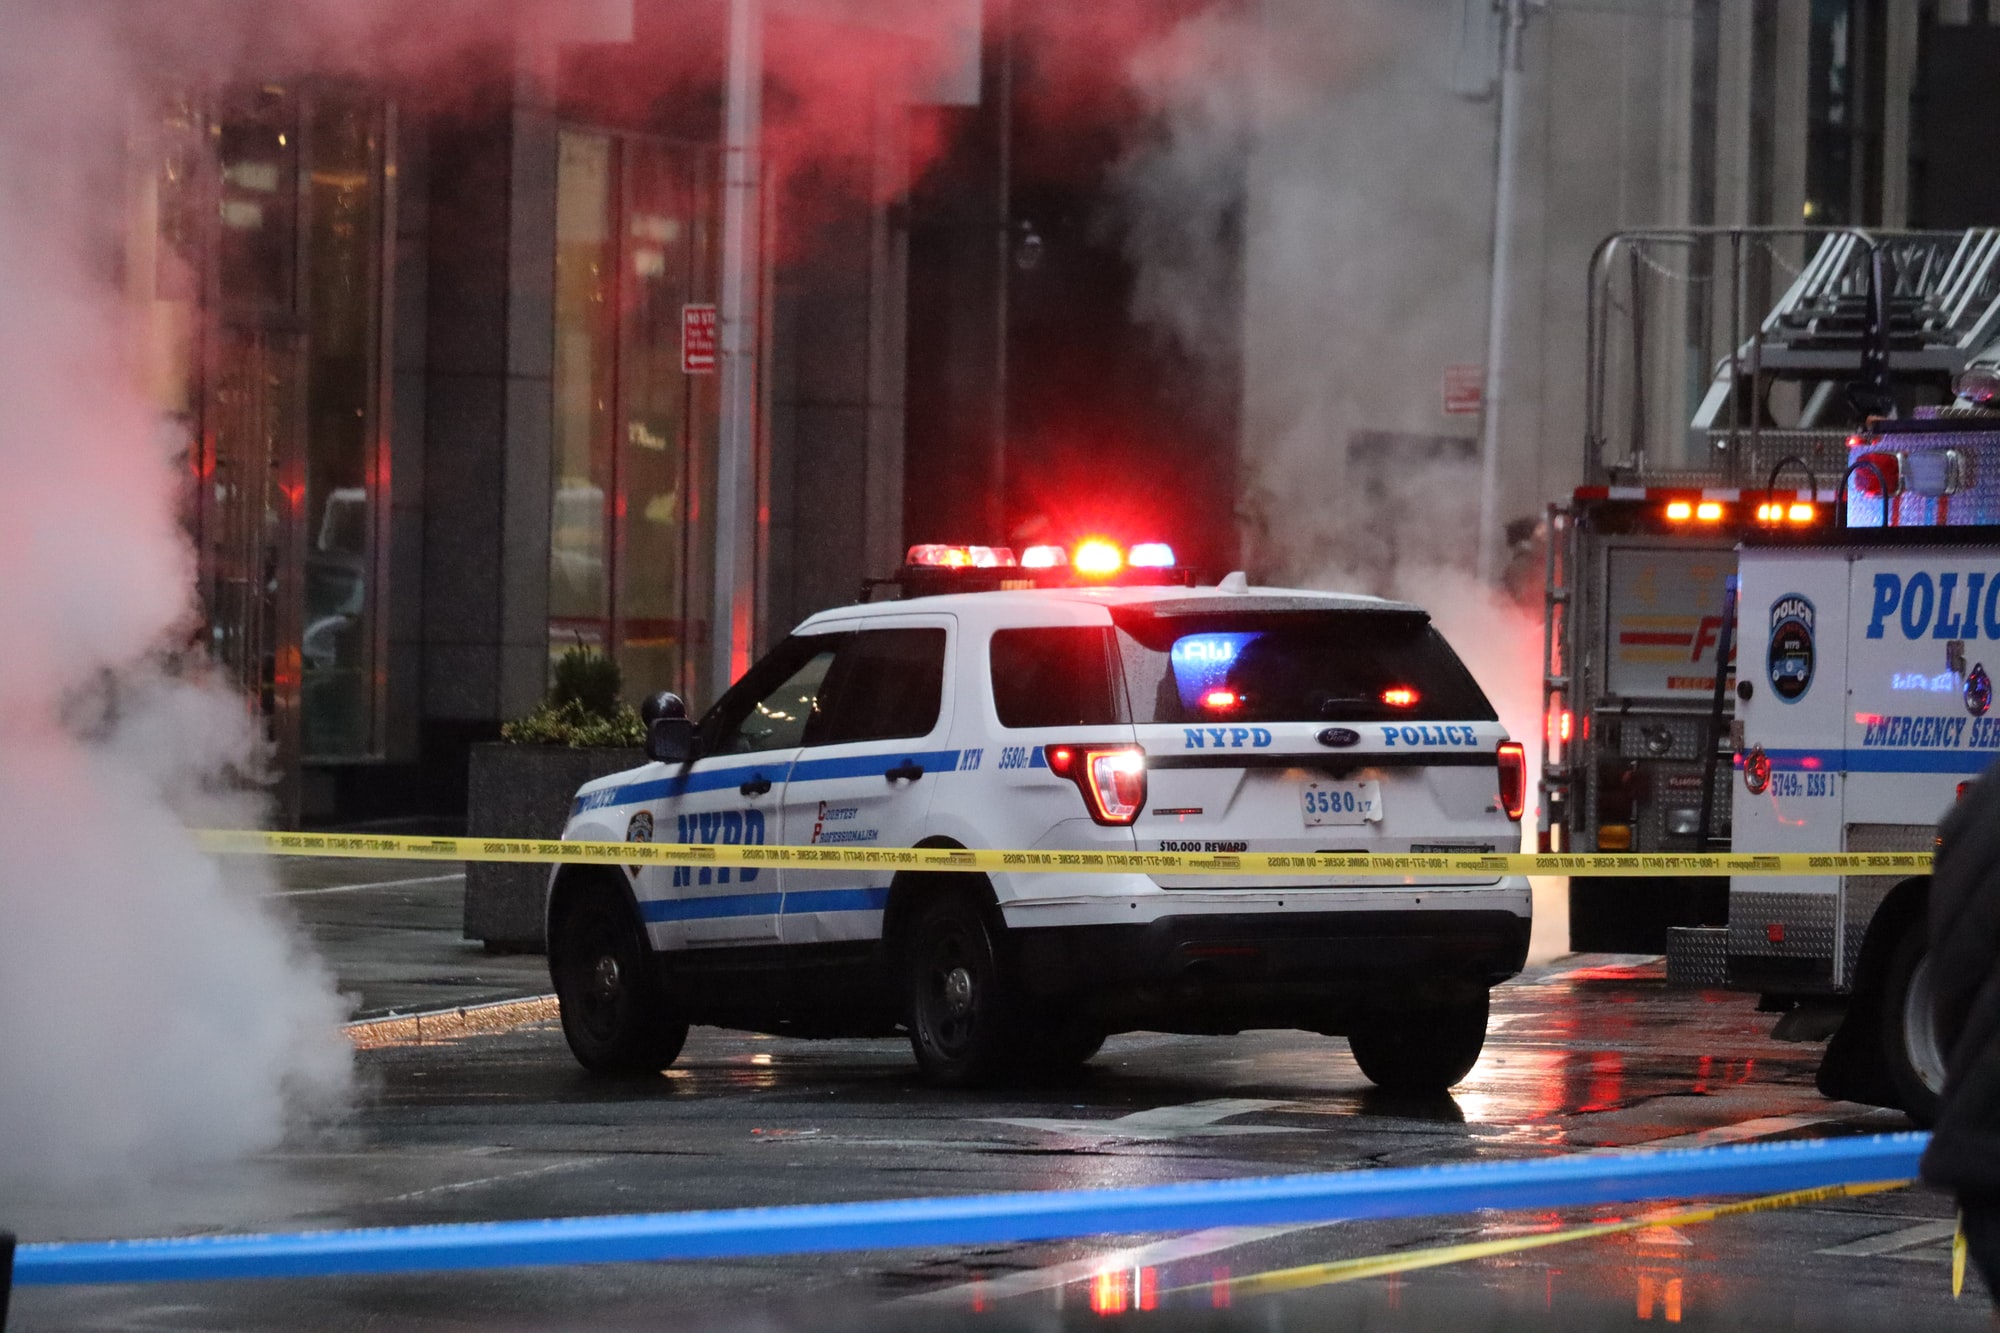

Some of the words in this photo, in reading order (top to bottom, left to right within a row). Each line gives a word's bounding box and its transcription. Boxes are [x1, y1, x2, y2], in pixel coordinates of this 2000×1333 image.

[687, 312, 699, 324] NO
[1184, 728, 1272, 749] NYPD
[1381, 725, 1477, 746] POLICE
[1863, 716, 1966, 747] EMERGENCY
[1771, 773, 1798, 797] 5749
[1806, 774, 1826, 797] ESS
[1305, 791, 1355, 813] 3580
[673, 809, 765, 887] NYPD
[1204, 841, 1247, 852] REWARD
